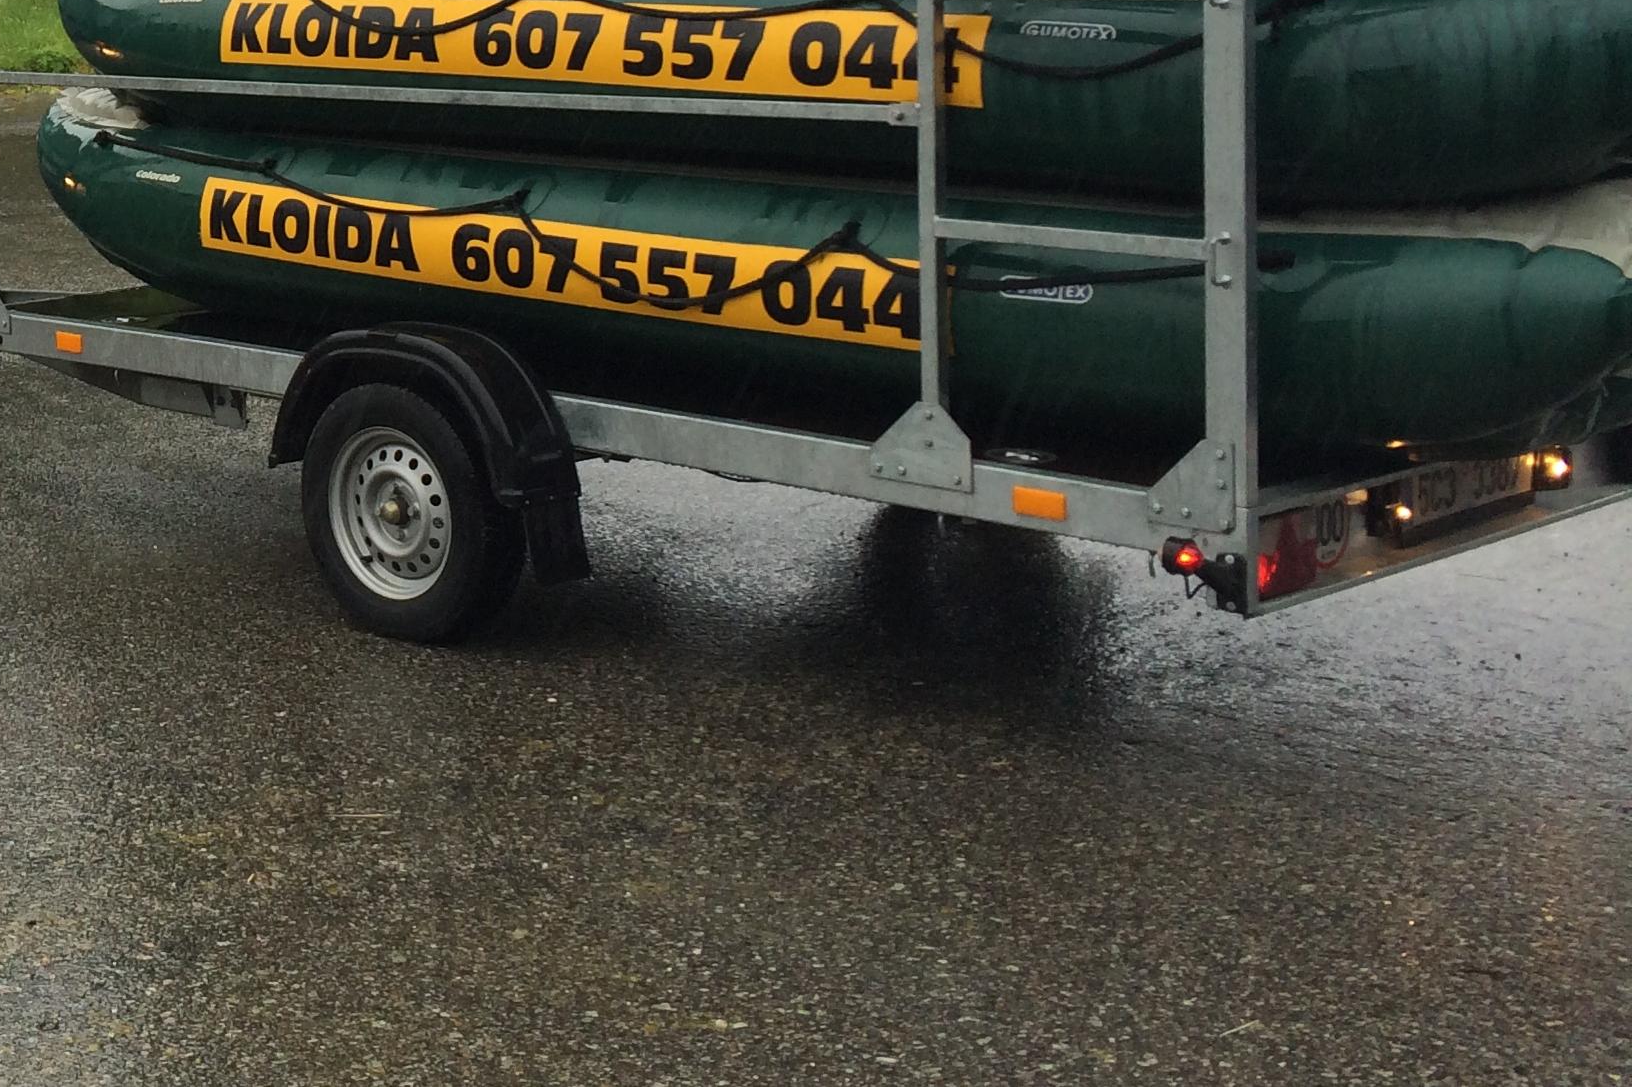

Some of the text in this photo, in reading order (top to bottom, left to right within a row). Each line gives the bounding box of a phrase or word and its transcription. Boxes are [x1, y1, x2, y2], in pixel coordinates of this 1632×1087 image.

[229, 2, 440, 64] KLOIDA
[472, 8, 604, 72] 607
[621, 14, 767, 82] 557
[208, 187, 921, 340] KLOIDA 607 557 044
